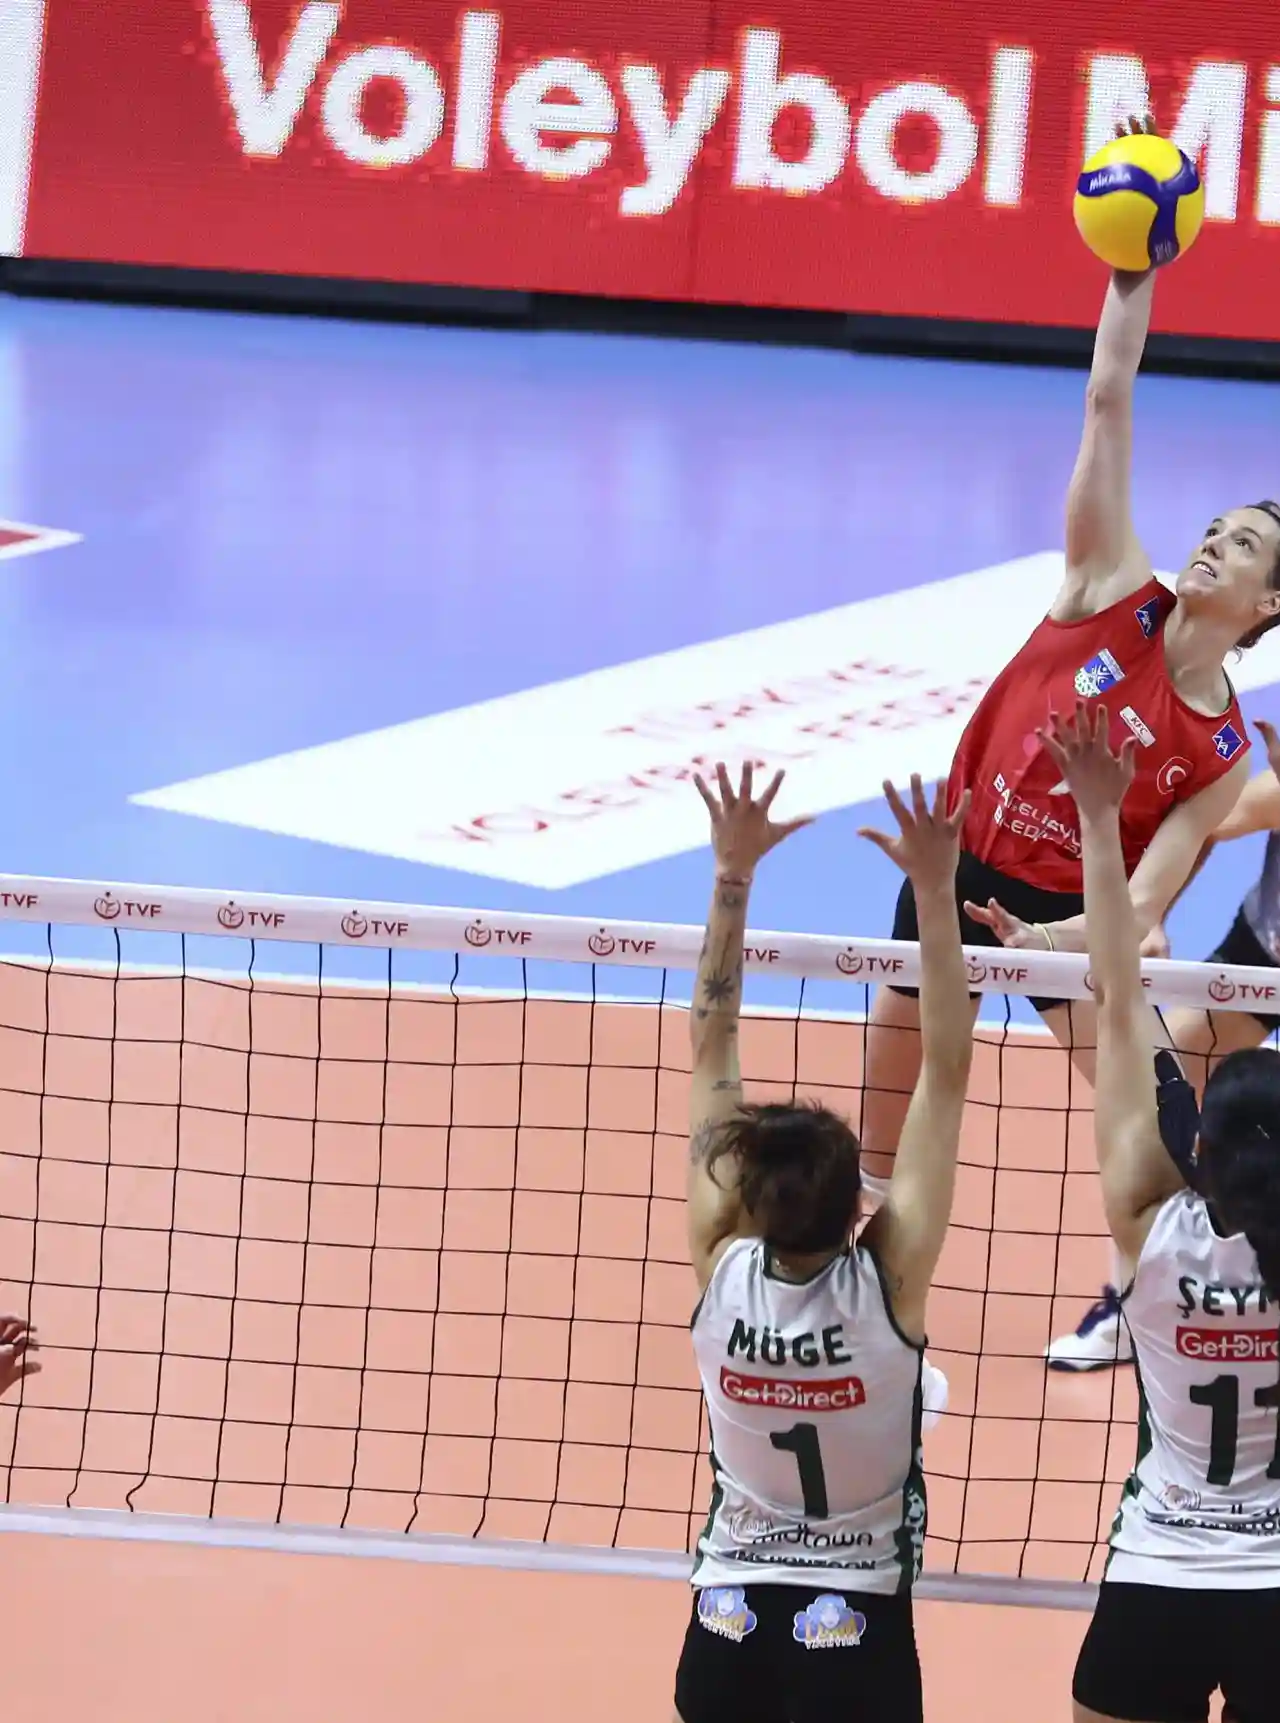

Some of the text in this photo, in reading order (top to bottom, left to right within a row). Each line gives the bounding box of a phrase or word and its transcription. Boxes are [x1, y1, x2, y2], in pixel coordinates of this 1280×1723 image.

[208, 0, 1034, 217] Voleybol
[0, 893, 38, 908] TVF
[124, 903, 162, 919] TVF
[248, 911, 286, 928] TVF
[371, 920, 409, 937] TVF
[495, 929, 533, 946] TVF
[618, 938, 656, 955] TVF
[866, 957, 904, 974] TVF
[990, 966, 1028, 983] TVF
[1239, 984, 1277, 1001] TVF
[727, 1318, 853, 1368] MÜGE
[722, 1376, 859, 1408] GetDirect
[769, 1421, 829, 1518] 1
